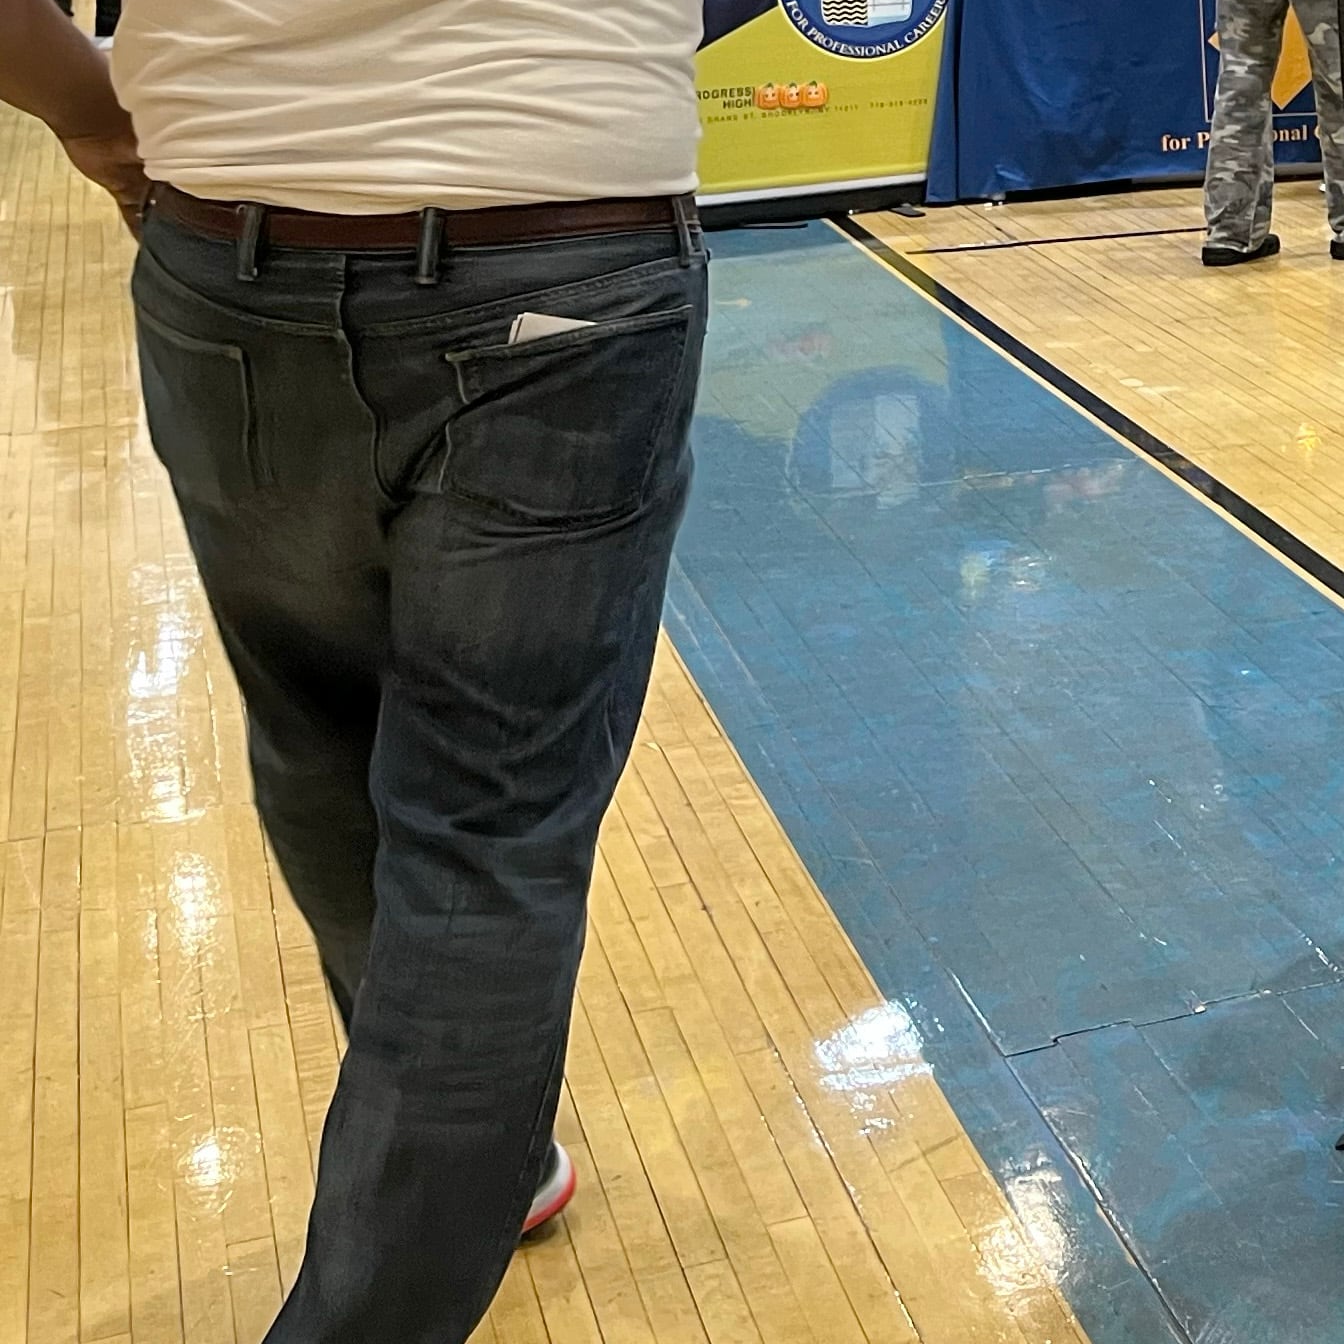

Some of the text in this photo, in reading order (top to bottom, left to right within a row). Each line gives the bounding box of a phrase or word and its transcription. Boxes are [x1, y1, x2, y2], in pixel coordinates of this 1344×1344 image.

[786, 0, 809, 32] FOR
[807, 27, 904, 56] PROFESSIONAL
[696, 87, 751, 100] OGRESS
[723, 99, 752, 109] HIGH
[1161, 133, 1191, 152] for
